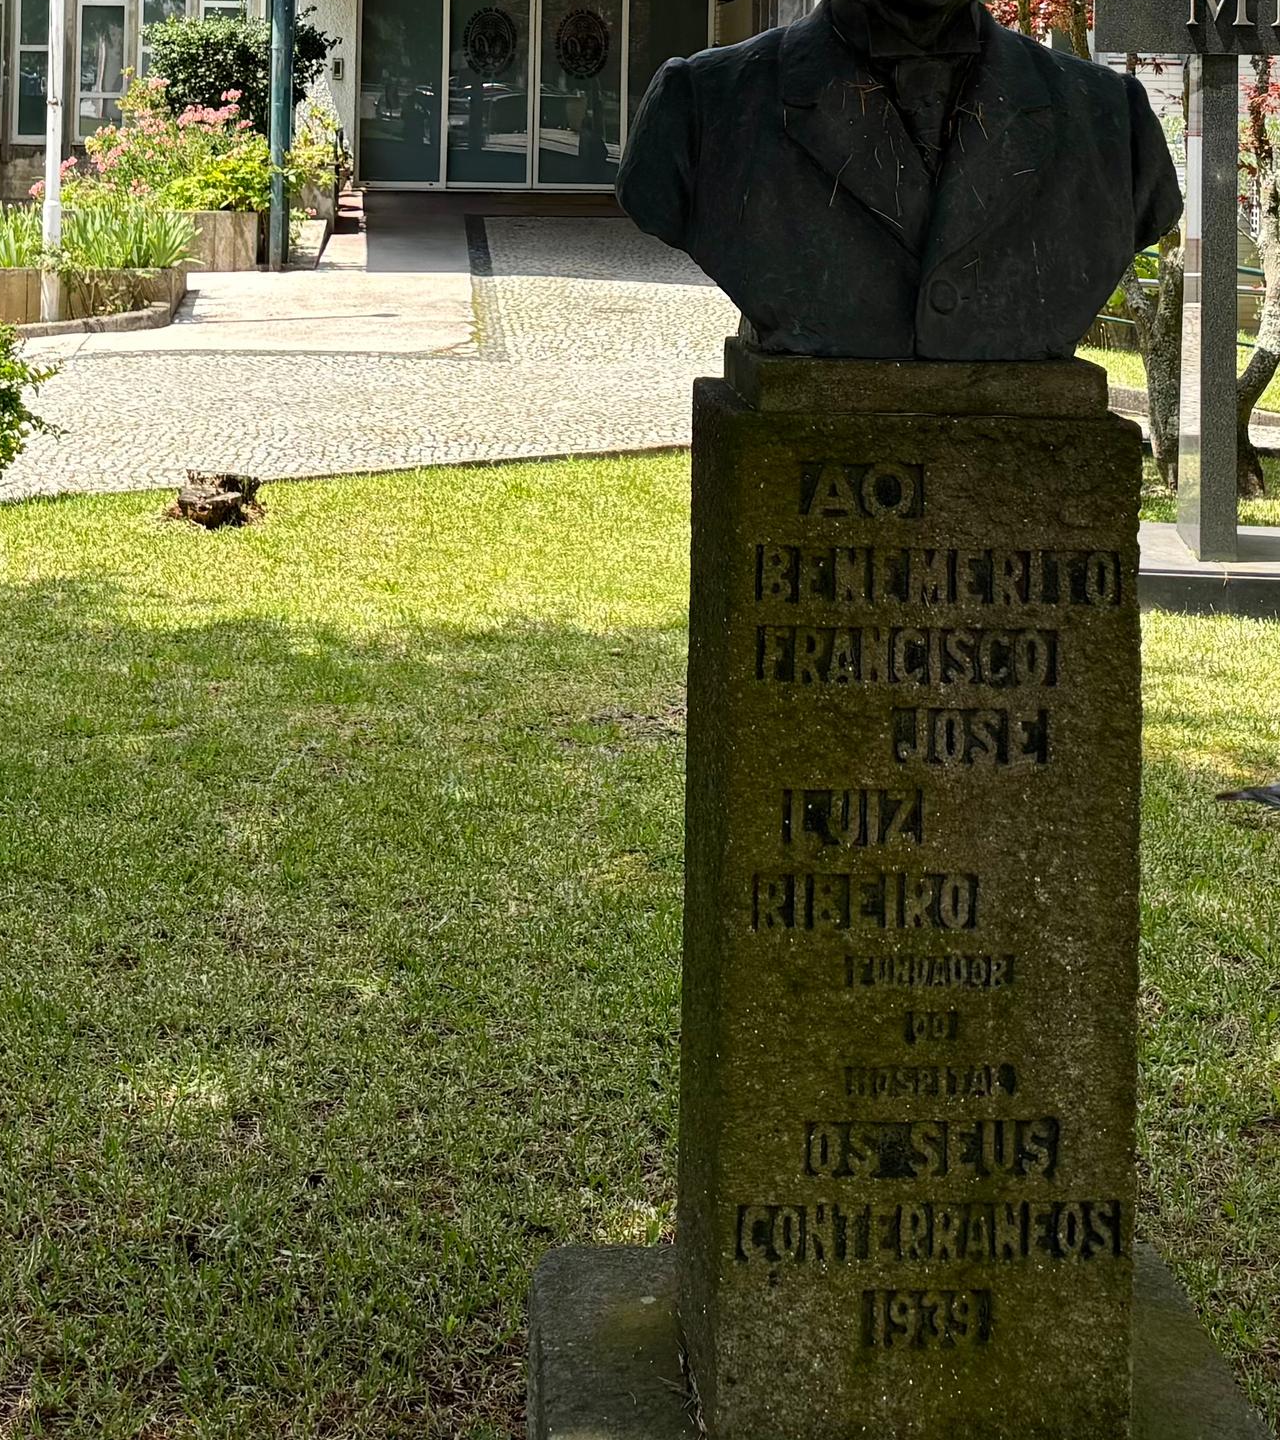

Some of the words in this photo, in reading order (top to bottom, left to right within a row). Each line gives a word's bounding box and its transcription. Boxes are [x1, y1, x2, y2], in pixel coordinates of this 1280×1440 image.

[802, 462, 923, 517] AO
[757, 545, 1120, 604] BENEMERITO
[757, 625, 1058, 686] FRANCISCO
[895, 707, 1047, 763] JOSE
[783, 789, 922, 845] LUIZ
[753, 873, 978, 929] RIBEIRO
[845, 954, 1014, 987] FUNDADOR
[905, 1010, 958, 1042] DO
[844, 1065, 1017, 1096] HOSPITAL
[806, 1121, 881, 1177] OS
[909, 1118, 1059, 1177] SEUS
[737, 1202, 1121, 1260] CONTERRANEOS
[863, 1289, 991, 1346] 1939
